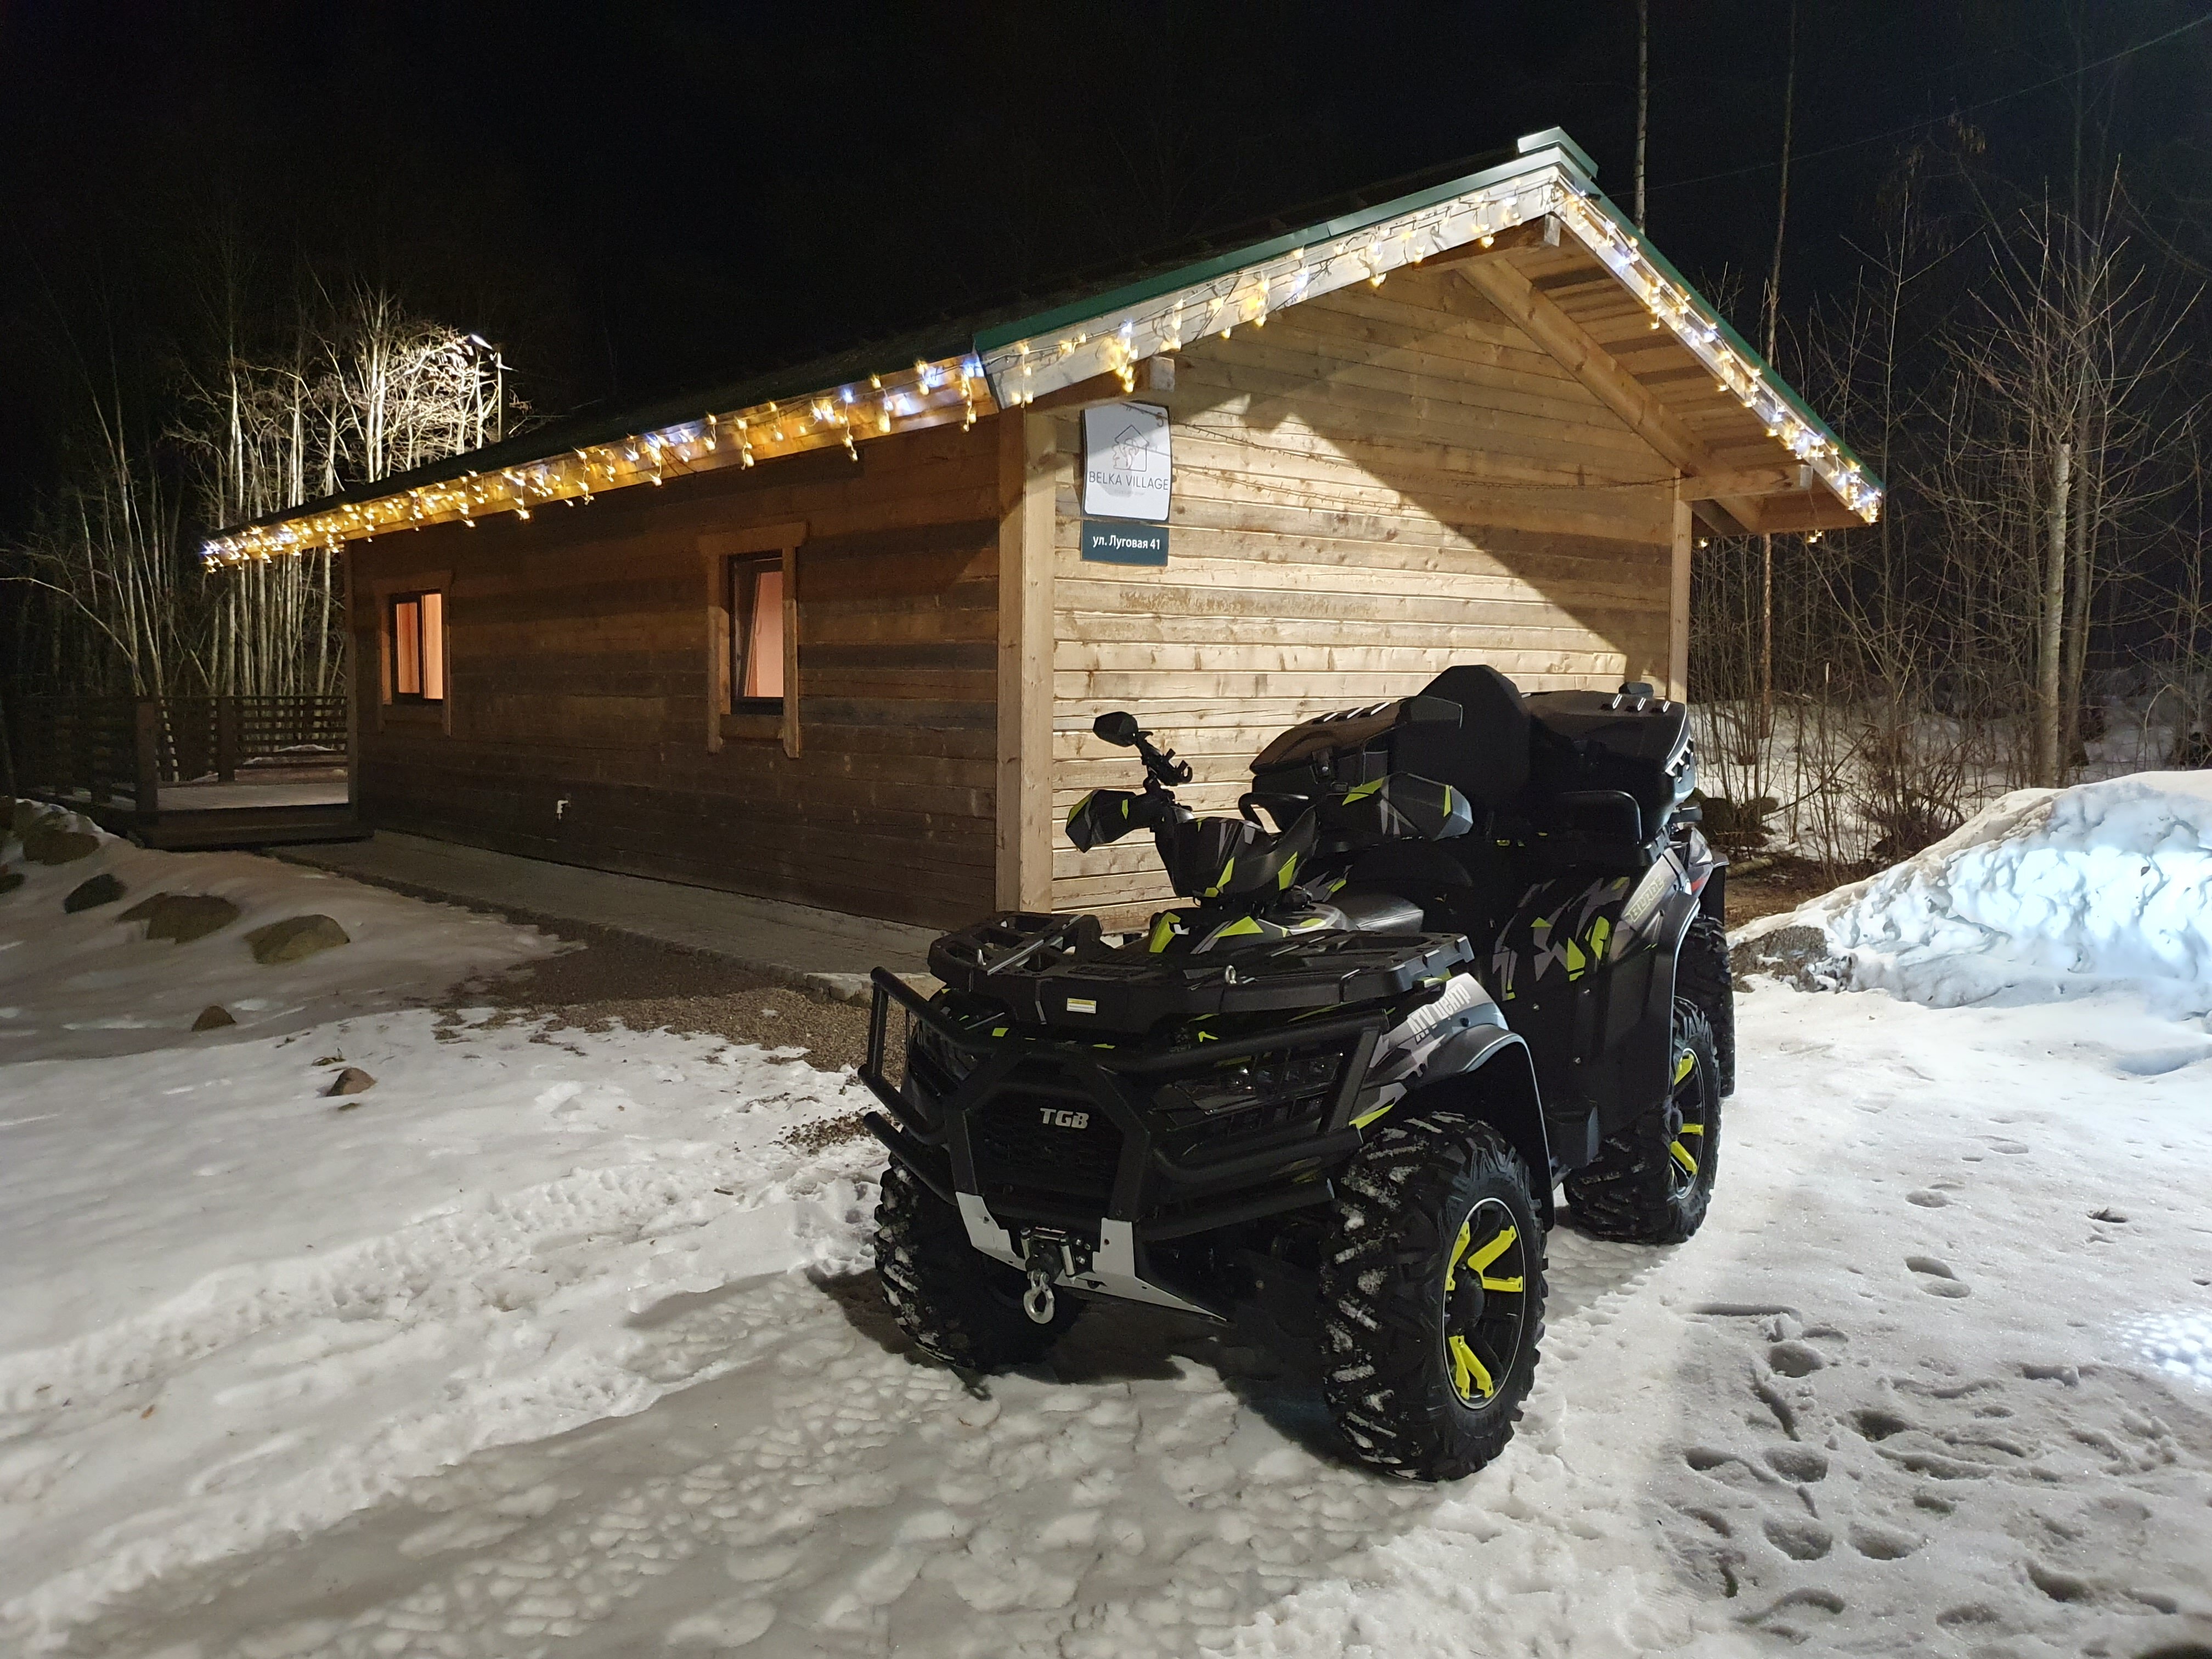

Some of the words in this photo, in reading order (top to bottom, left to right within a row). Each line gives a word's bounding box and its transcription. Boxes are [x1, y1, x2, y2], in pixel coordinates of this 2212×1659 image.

[1090, 471, 1122, 485] BELKA
[1126, 475, 1169, 490] VILLAGE
[1093, 535, 1107, 548] ул.
[1109, 535, 1148, 550] Луговая
[1150, 538, 1160, 550] 41
[1624, 874, 1664, 923] BLADE
[1407, 1005, 1437, 1043] ATV
[1040, 1108, 1089, 1128] TGB
